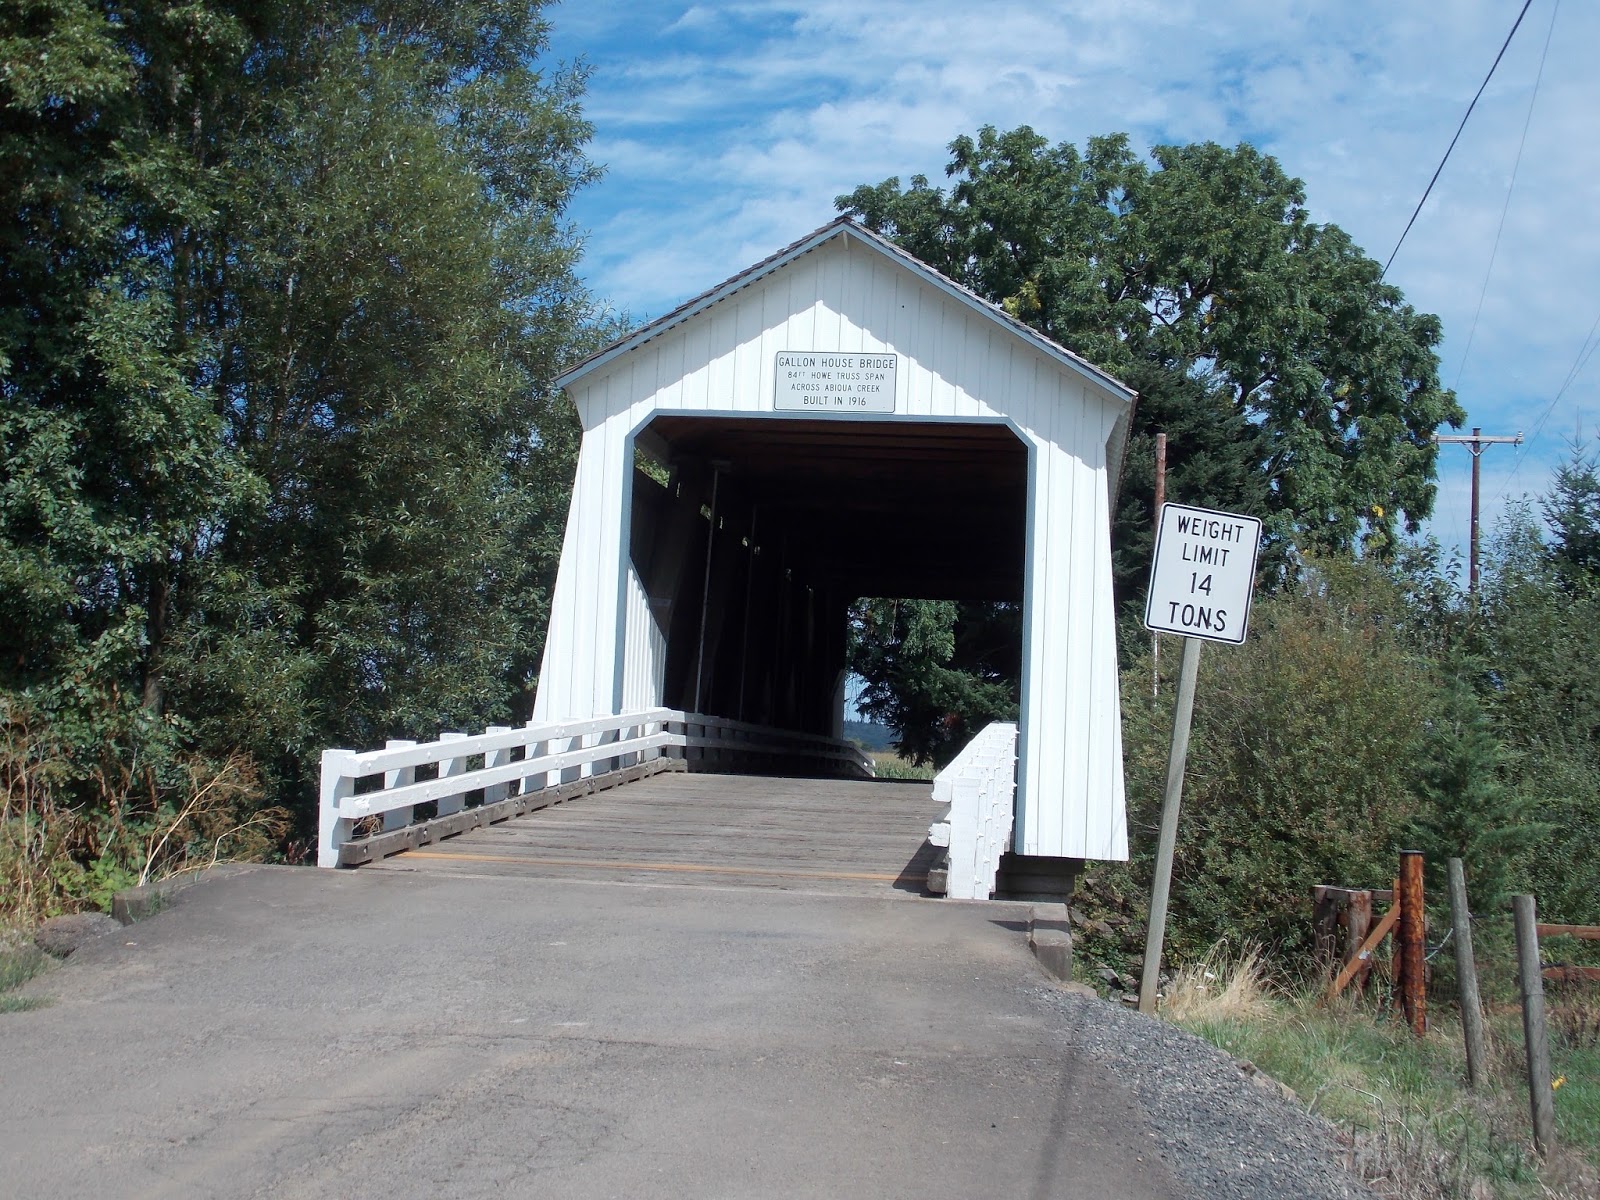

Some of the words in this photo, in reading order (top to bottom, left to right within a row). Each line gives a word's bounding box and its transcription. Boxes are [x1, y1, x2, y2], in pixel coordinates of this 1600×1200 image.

[779, 357, 815, 367] GALLON
[821, 358, 853, 368] HOUSE
[860, 359, 894, 369] BRIDGE
[837, 372, 860, 380] TRUSS
[791, 383, 820, 391] ACROSS
[803, 396, 828, 405] BUILT
[834, 396, 843, 405] IN
[849, 397, 866, 406] 1916
[1178, 515, 1244, 543] WEIGHT
[1182, 543, 1230, 566] LIMIT
[1190, 572, 1212, 596] 14
[1169, 601, 1227, 631] TONS
